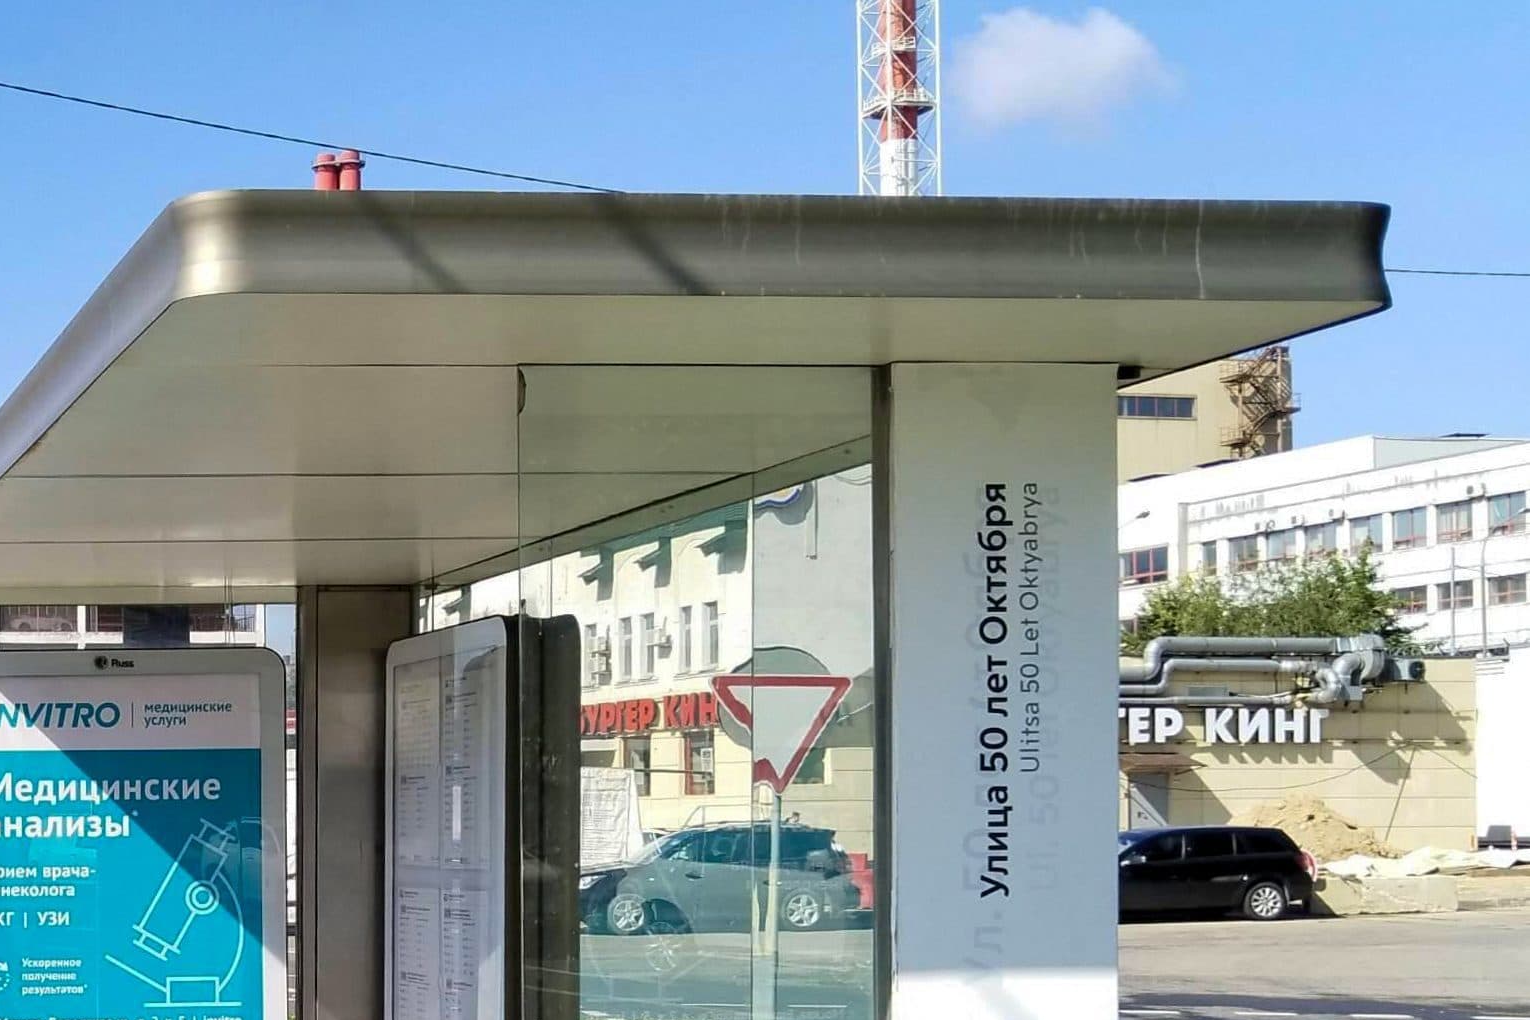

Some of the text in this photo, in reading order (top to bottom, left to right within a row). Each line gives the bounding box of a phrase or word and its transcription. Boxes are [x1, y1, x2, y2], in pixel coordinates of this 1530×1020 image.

[977, 483, 1014, 645] Октября
[1018, 482, 1043, 772] Ulitsa 50 Let Oktyabrya
[111, 658, 135, 668] Russ
[987, 655, 1008, 717] лет
[144, 701, 233, 715] медицинские
[581, 691, 719, 734] УРГЕР КИН
[144, 715, 187, 729] услуги
[1205, 707, 1330, 744] КИНГ
[980, 727, 1008, 772] 50
[980, 785, 1013, 898] Улица
[42, 866, 97, 881] врача-
[37, 911, 70, 927] УЗИ
[22, 957, 82, 970] Ускоренное
[22, 972, 77, 983] получение
